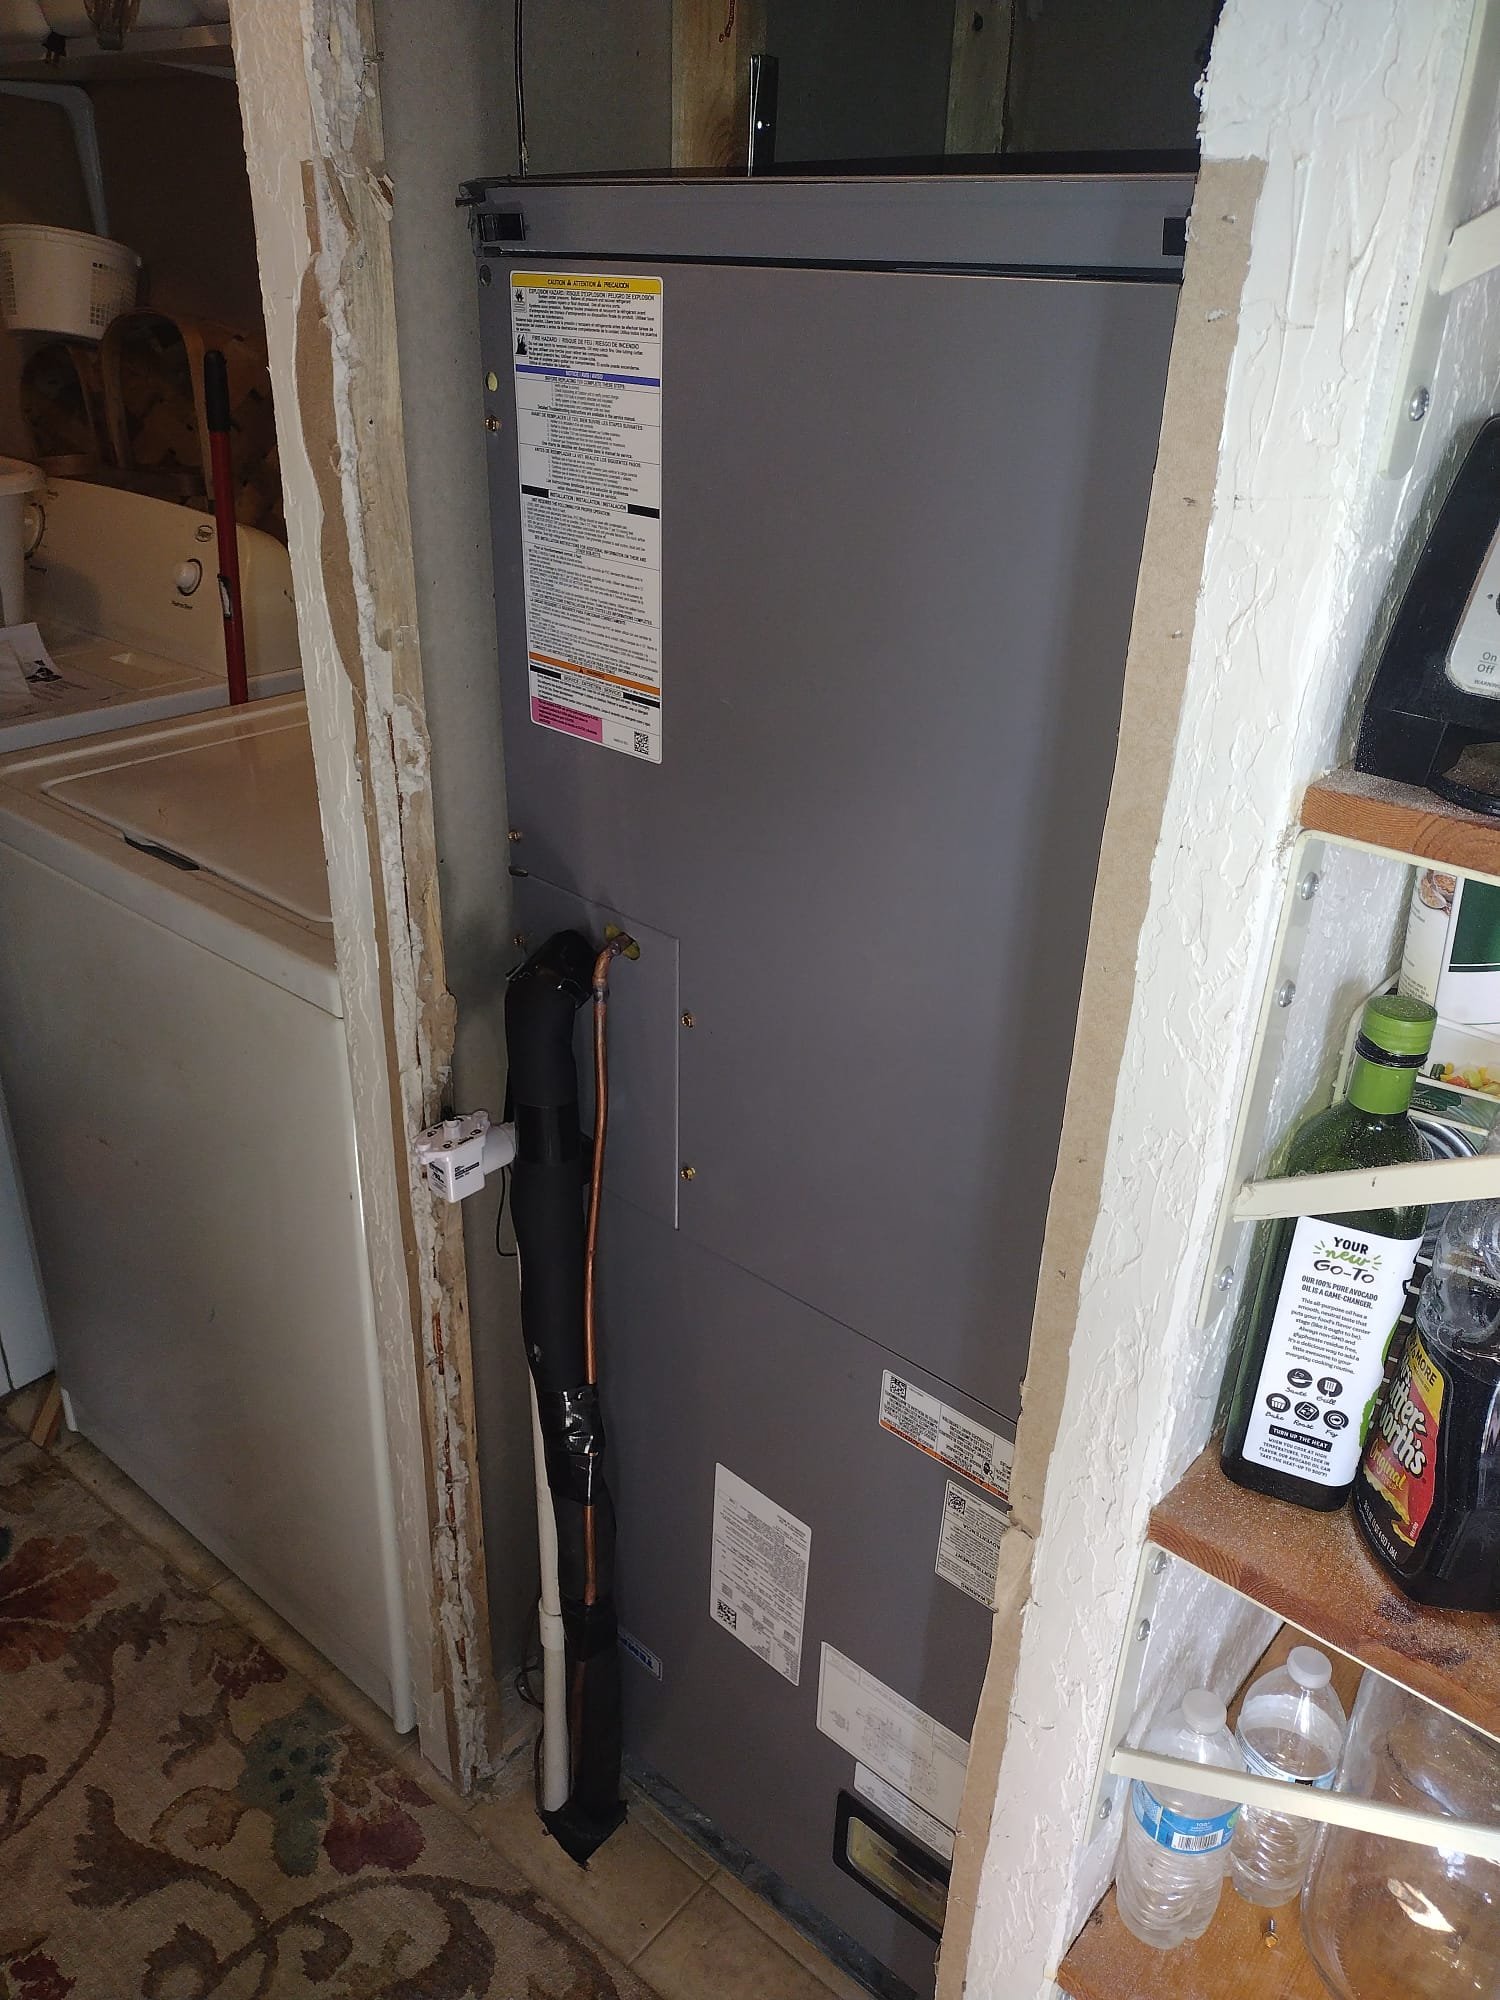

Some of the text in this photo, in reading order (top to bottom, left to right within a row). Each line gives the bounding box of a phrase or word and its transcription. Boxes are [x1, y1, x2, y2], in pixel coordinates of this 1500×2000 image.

[1482, 651, 1498, 662] On
[1477, 663, 1496, 674] Off
[1334, 1236, 1369, 1255] YOUR
[1325, 1249, 1371, 1266] new
[1301, 1275, 1378, 1302] OUR 100% PURE AVOCADO
[1301, 1284, 1374, 1309] OIL IS A GAME-CHANGER.
[1298, 1304, 1367, 1327] smooth, neutral taste that
[1302, 1297, 1313, 1305] This
[1313, 1300, 1344, 1314] all-purpose
[1353, 1310, 1363, 1318] has
[1296, 1318, 1310, 1326] stage
[1311, 1321, 1323, 1330] (like
[1328, 1326, 1344, 1335] ought
[1304, 1312, 1318, 1321] your
[1318, 1316, 1334, 1325] food's
[1335, 1320, 1352, 1330] flavor
[1352, 1326, 1371, 1335] center
[1293, 1332, 1324, 1344] glyphosate
[1324, 1340, 1344, 1350] residue
[1298, 1326, 1356, 1346] Always non-GMO and
[1300, 1340, 1325, 1352] delicious
[1325, 1348, 1337, 1356] way
[1344, 1353, 1356, 1361] add
[1305, 1350, 1331, 1360] awesome
[1285, 1351, 1356, 1375] everyday cooking routine.
[1416, 1348, 1437, 1386] MORE
[1316, 1396, 1336, 1406] Grill
[1265, 1411, 1285, 1421] Bake
[1293, 1420, 1314, 1430] Roast
[1272, 1428, 1328, 1449] TURN UP THE HEAT
[1324, 1429, 1339, 1438] Fry
[1263, 1442, 1300, 1457] TEMPERATURES,
[1310, 1456, 1323, 1464] LOCK
[1268, 1438, 1282, 1446] WHEN
[1294, 1445, 1306, 1453] COOK
[1314, 1452, 1328, 1460] HIGH
[1259, 1452, 1272, 1460] TAKE
[1272, 1456, 1282, 1464] THE
[1282, 1460, 1304, 1470] HEAT-UP
[1288, 1455, 1312, 1466] AVOCADO
[1370, 1438, 1407, 1491] Original
